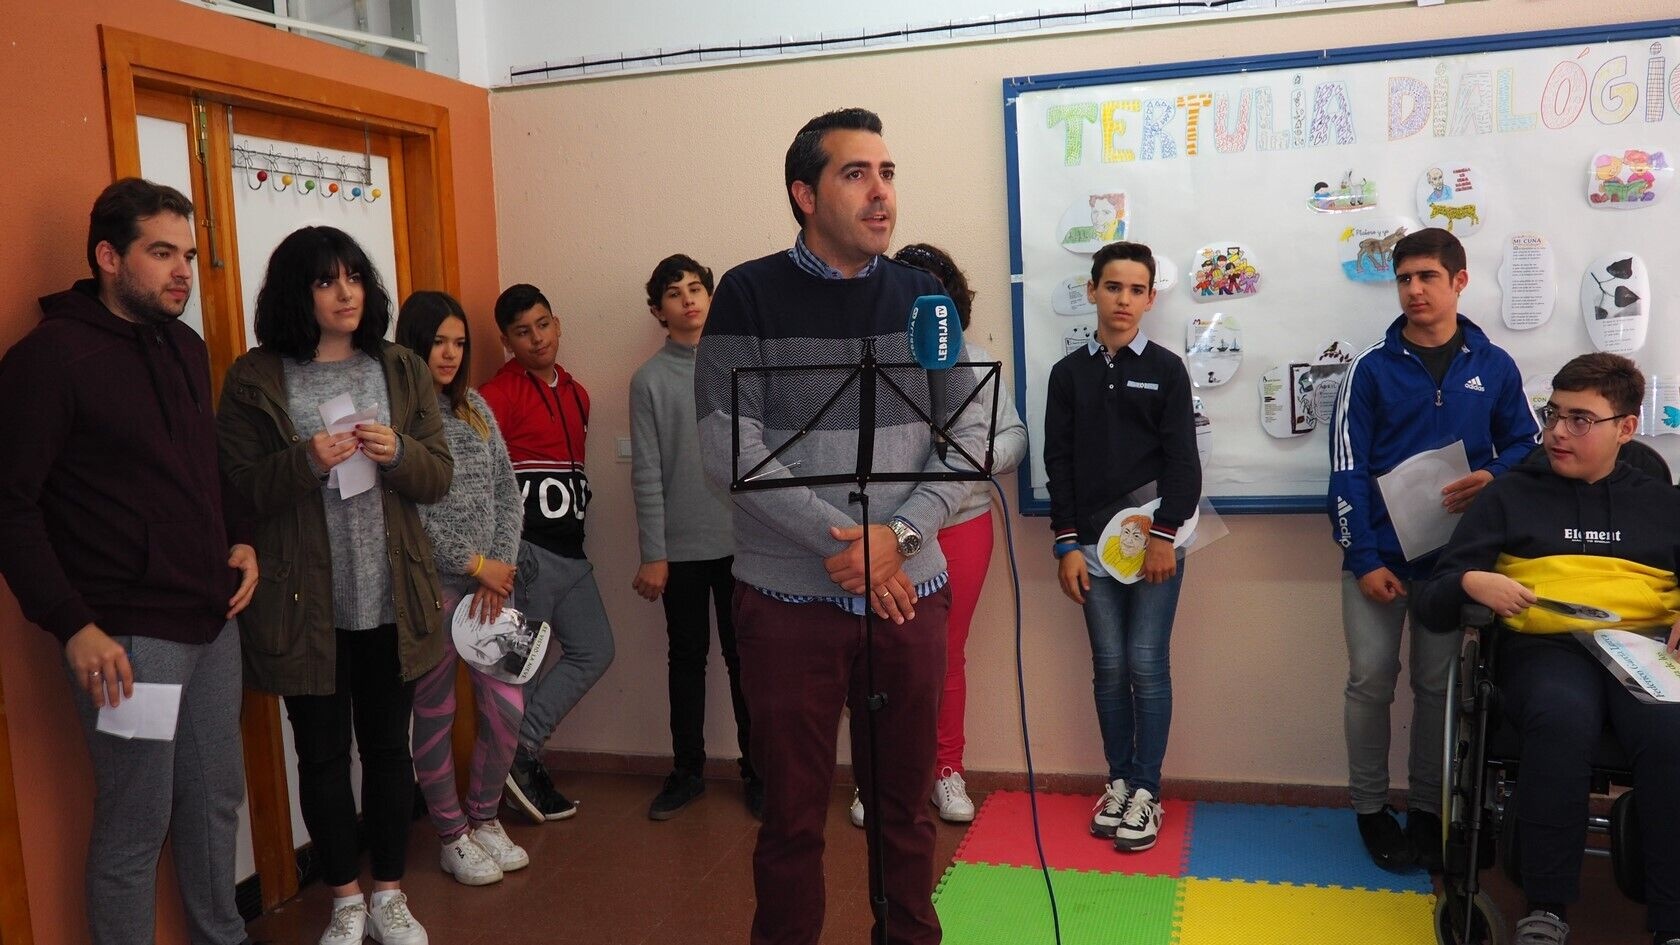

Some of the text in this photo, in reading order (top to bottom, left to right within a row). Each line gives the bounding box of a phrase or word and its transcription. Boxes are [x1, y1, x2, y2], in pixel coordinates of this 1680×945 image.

[1388, 41, 1680, 141] DIALÓGI
[938, 318, 948, 361] LEBRIJA
[1465, 383, 1485, 392] adidas
